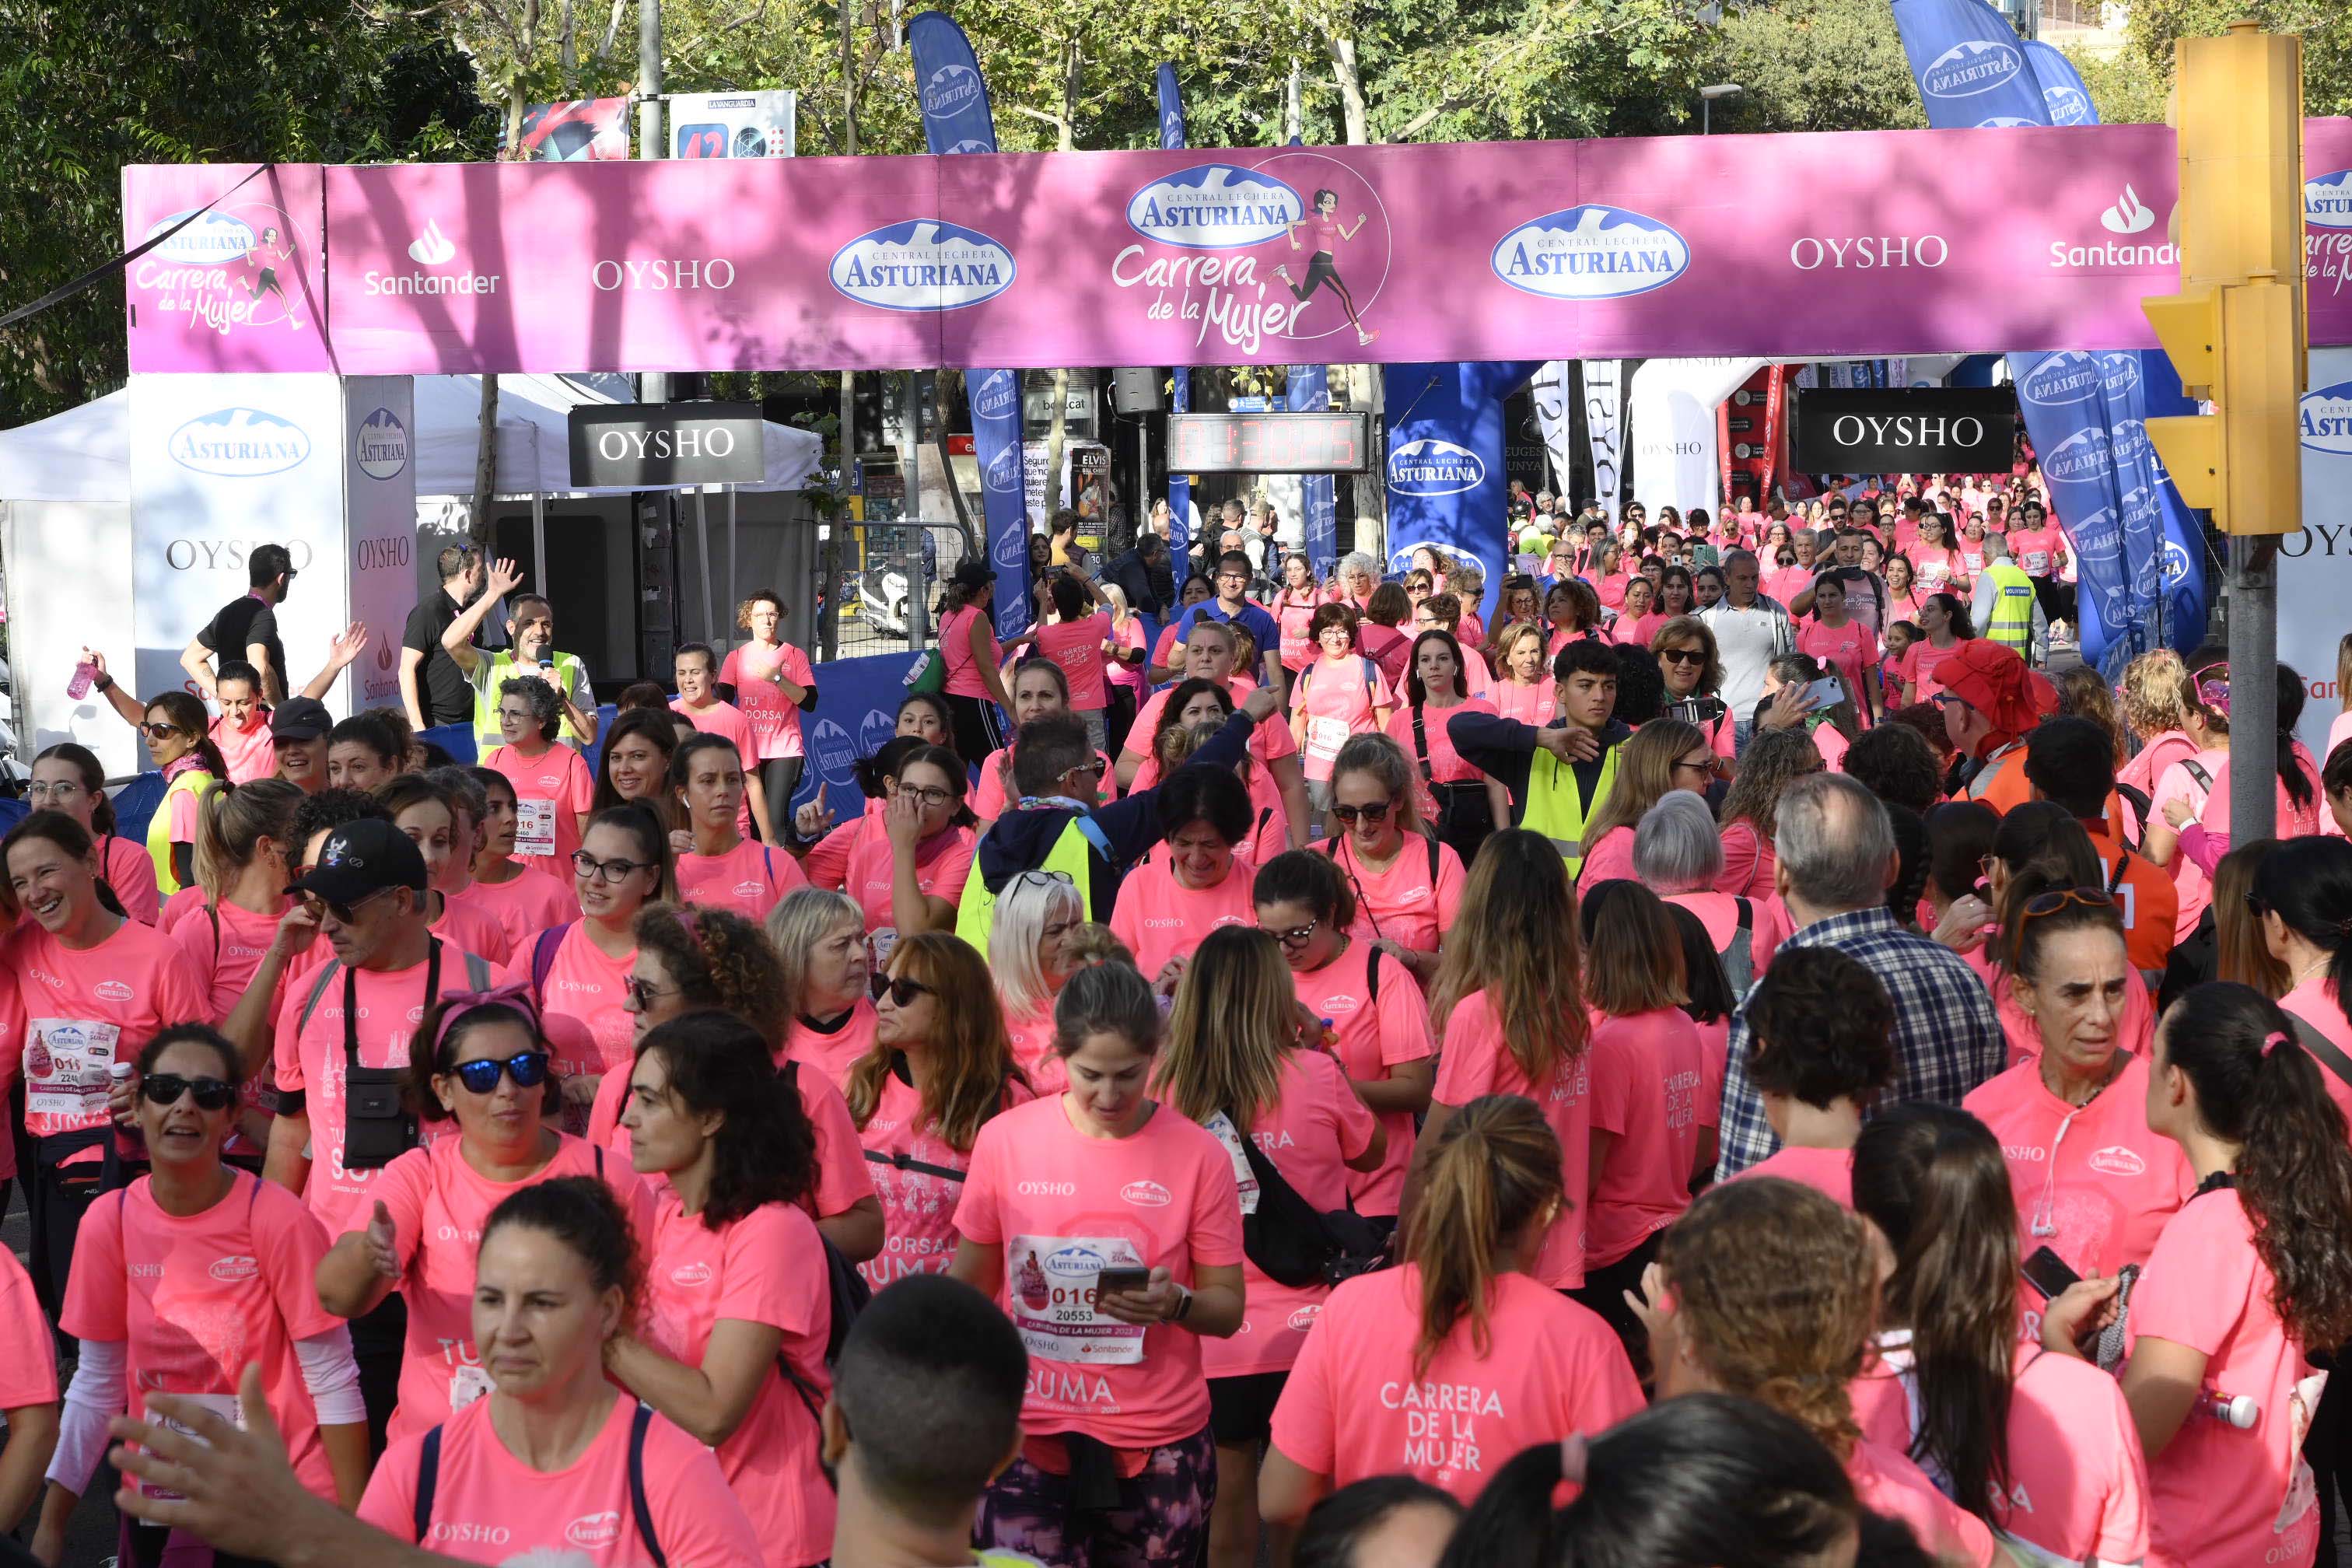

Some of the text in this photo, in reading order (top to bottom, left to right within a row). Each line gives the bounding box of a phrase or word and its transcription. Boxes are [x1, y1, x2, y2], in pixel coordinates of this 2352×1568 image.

[1167, 192, 1286, 202] CENTRAL LECHERA
[1140, 196, 1290, 227] ASTURIANA
[1537, 236, 1668, 248] CENTRAL LECHERA
[1790, 235, 1948, 270] OYSHO
[872, 249, 996, 261] CENTRAL LECHERA
[1112, 244, 1257, 288] Carrera
[1507, 241, 1675, 277] ASTURIANA
[136, 261, 228, 291] Carrera
[592, 257, 736, 291] OYSHO
[843, 254, 1003, 288] ASTURIANA
[2322, 256, 2336, 278] la
[365, 270, 500, 296] Santander
[158, 286, 261, 335] de la Mujer
[1147, 282, 1312, 355] de la Mujer
[1832, 415, 1984, 448] OYSHO
[2300, 408, 2352, 436] ASTU
[180, 432, 301, 460] ASTURIANA
[360, 435, 404, 463] ASTURIANA
[598, 427, 736, 460] OYSHO
[1505, 446, 1542, 457] EUGES
[1082, 455, 1106, 465] ELVIS
[1506, 461, 1543, 472] UNYA
[1024, 468, 1037, 478] que
[1390, 462, 1478, 484] ASTURIANA
[1025, 499, 1040, 507] este
[166, 538, 313, 571] OYSO
[358, 536, 409, 571] OYSHO
[1058, 644, 1093, 656] CARRERA
[744, 697, 758, 706] TU
[819, 748, 855, 772] ASTURIANA
[518, 821, 534, 830] 16
[1144, 918, 1184, 928] OYSHO
[30, 969, 65, 988] OYSHO
[558, 979, 602, 994] OYSHO
[324, 1007, 369, 1019] OYSO
[1549, 1078, 1589, 1102] MUJER
[1663, 1070, 1701, 1095] CARRERA
[37, 1098, 65, 1107] OYSHO
[1667, 1108, 1693, 1129] MUJER
[1017, 1181, 1076, 1196] OYSHO
[438, 1225, 481, 1243] OYSH
[883, 1236, 957, 1255] ORSAL
[1050, 1258, 1101, 1272] ASTURIANA
[1052, 1287, 1097, 1304] 016
[1056, 1310, 1093, 1322] 20553
[1059, 1325, 1070, 1334] DE
[1071, 1325, 1083, 1335] LA
[1085, 1326, 1113, 1335] MUJER
[437, 1337, 481, 1367] TU
[1094, 1344, 1134, 1354] Santander
[1380, 1381, 1504, 1418] CARRERA
[1409, 1410, 1476, 1444] DE LA
[1404, 1439, 1482, 1472] MUJER
[433, 1521, 510, 1544] OYSHO
